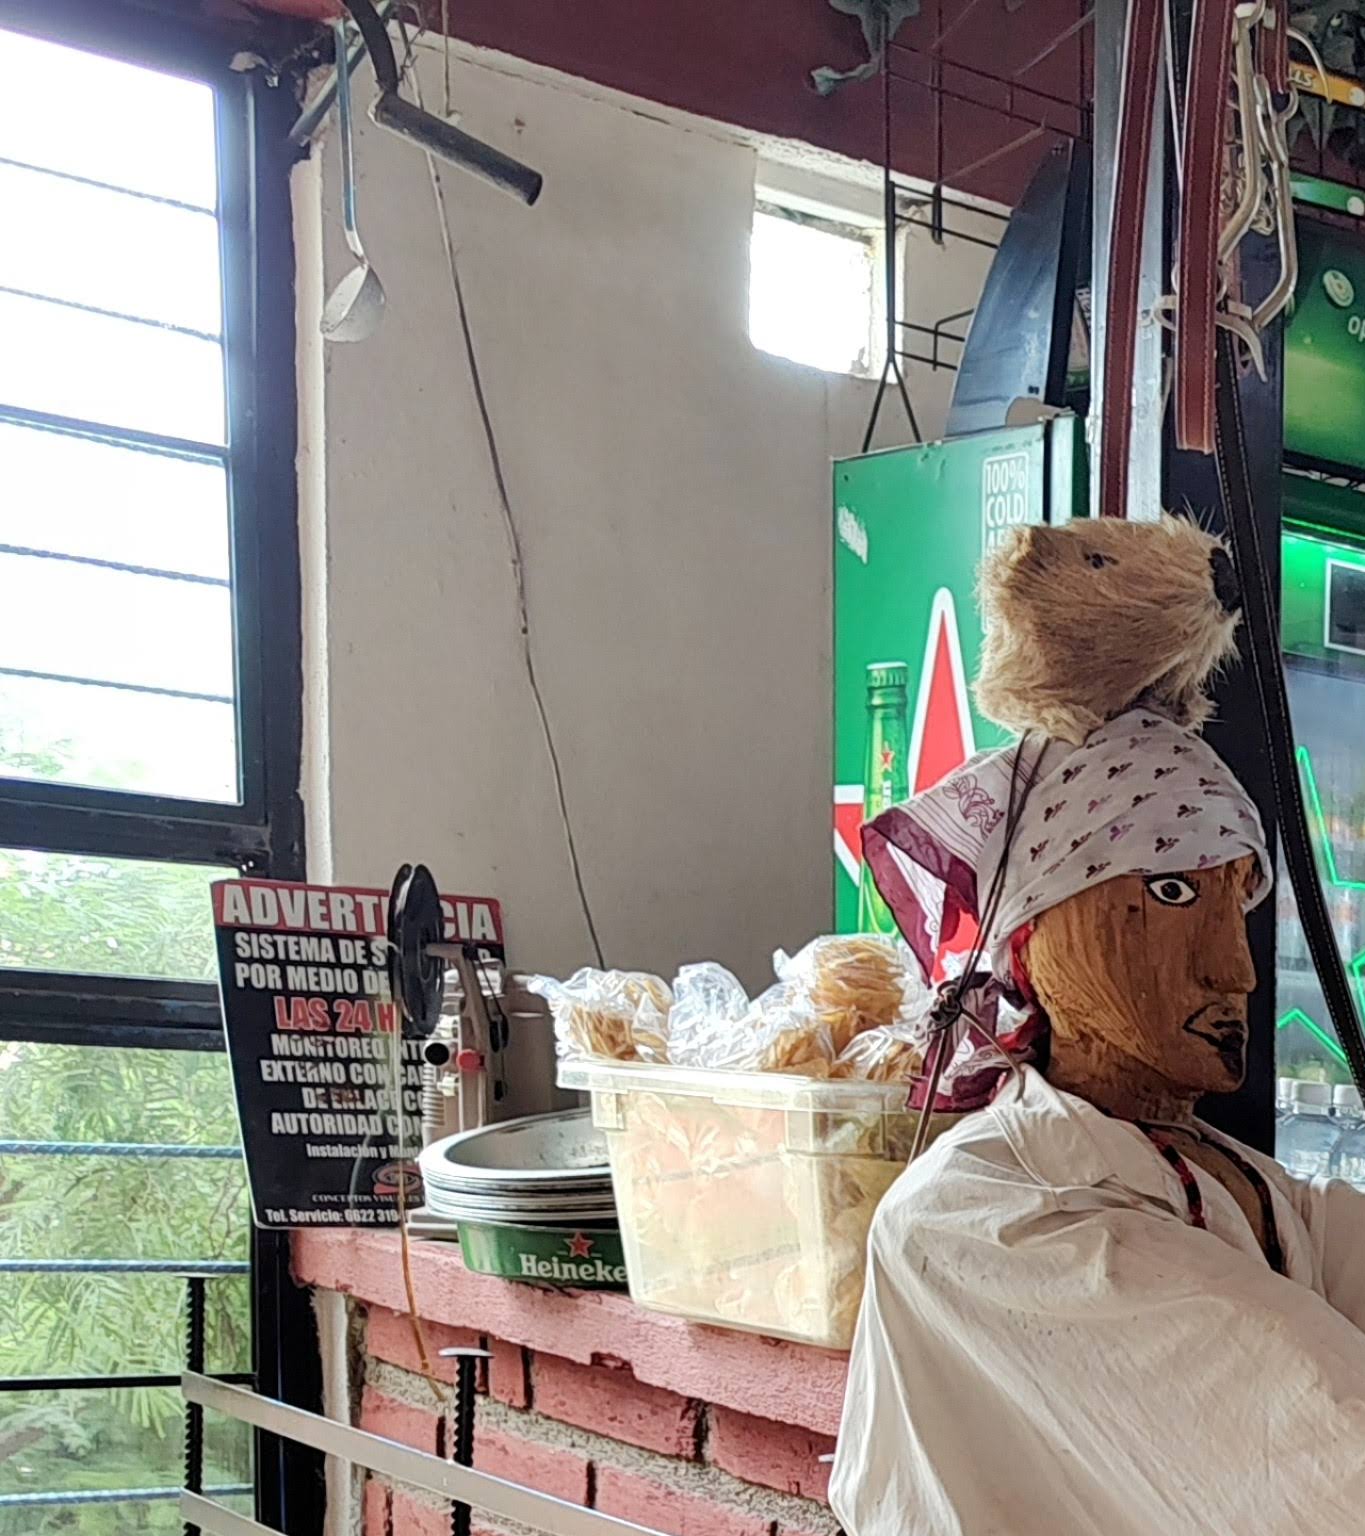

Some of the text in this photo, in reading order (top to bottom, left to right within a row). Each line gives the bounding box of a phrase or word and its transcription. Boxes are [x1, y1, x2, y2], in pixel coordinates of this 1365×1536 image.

[985, 459, 1026, 494] 100%
[986, 493, 1025, 528] COLD
[222, 883, 497, 942] ADVERTCIA
[234, 931, 331, 964] SISTEMA
[338, 938, 367, 965] DE
[235, 962, 283, 990] POR
[287, 965, 359, 994] MEDIO
[274, 996, 331, 1031] LAS
[333, 998, 373, 1033] 24
[260, 1059, 347, 1084] EXTERNO
[350, 1063, 391, 1086] CON
[271, 1111, 383, 1136] AUTORIDAD
[289, 1208, 345, 1223] Servicio:
[518, 1253, 628, 1282] Heineke
